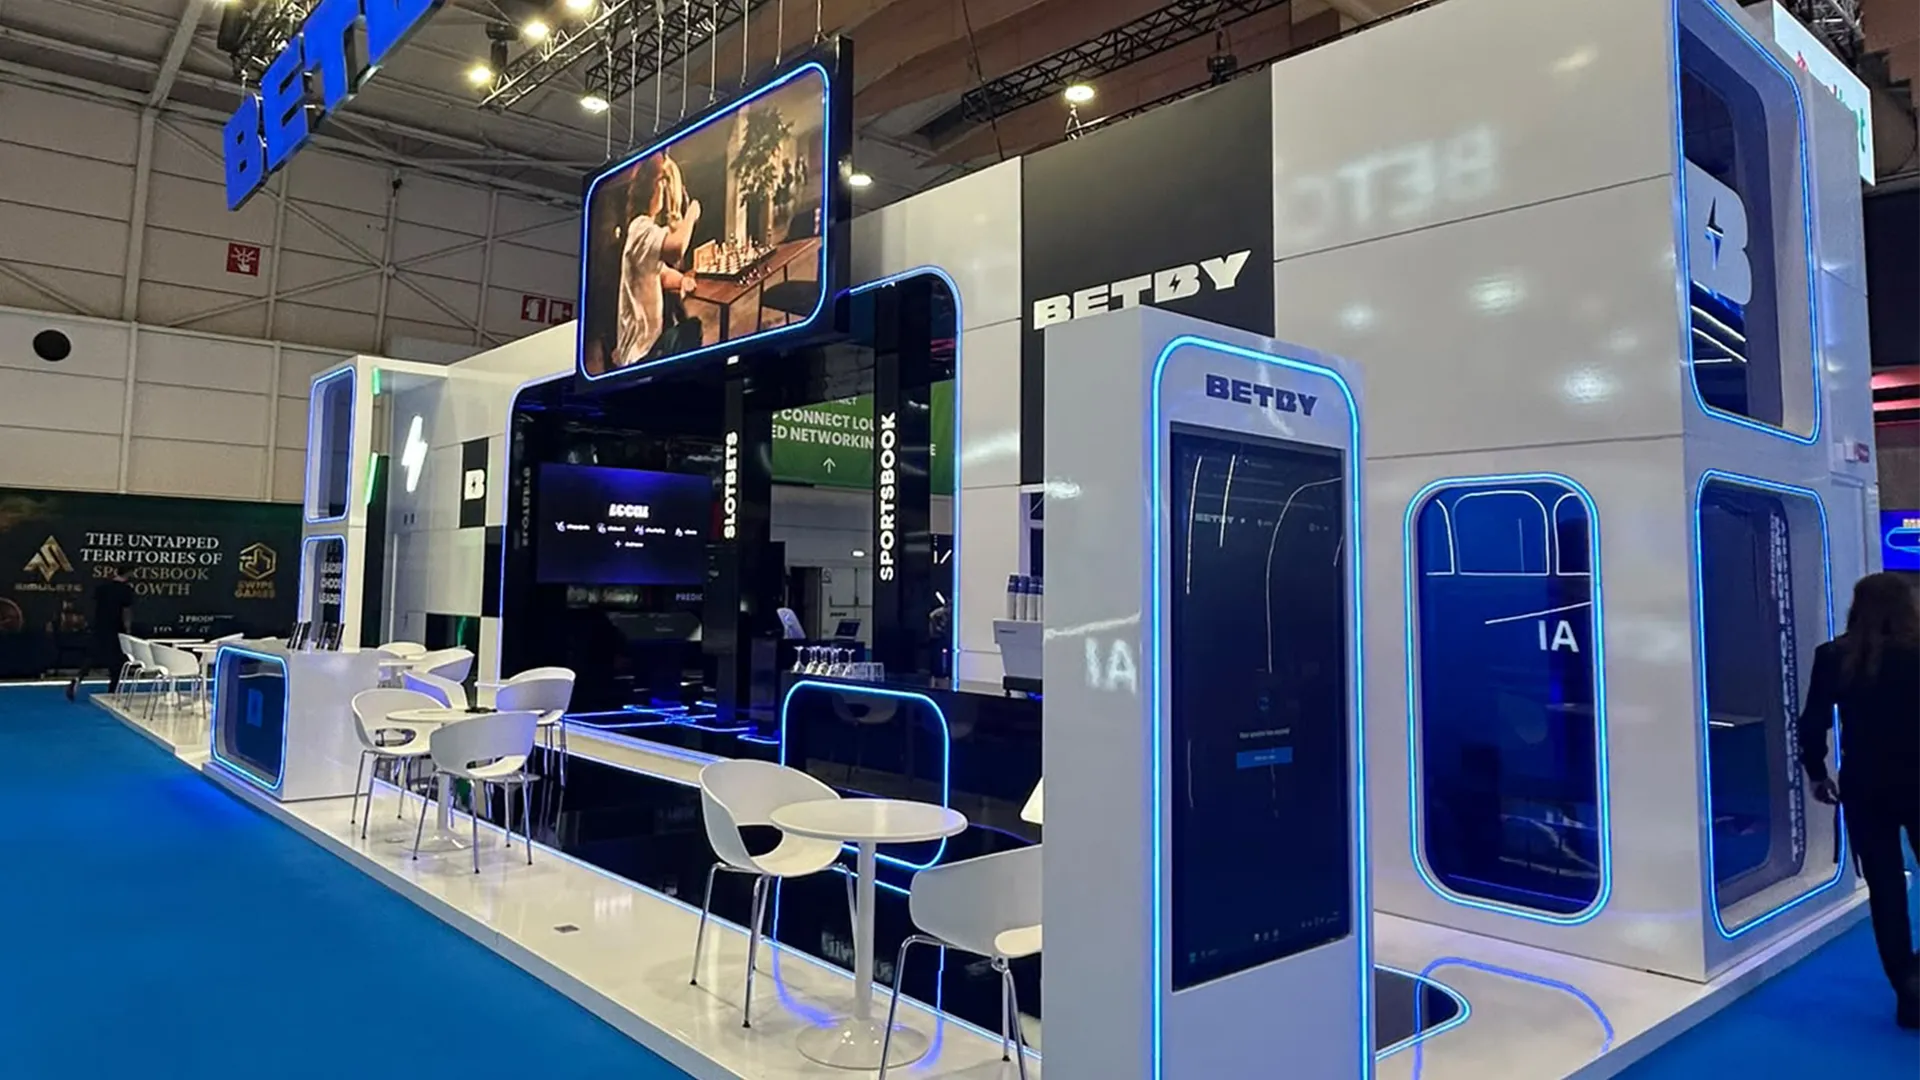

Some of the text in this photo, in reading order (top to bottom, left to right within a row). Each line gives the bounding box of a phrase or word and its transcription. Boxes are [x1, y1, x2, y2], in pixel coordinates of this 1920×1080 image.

[1033, 249, 1252, 330] BETBY
[1206, 374, 1318, 416] BETBY
[781, 408, 850, 428] CONNECT
[723, 431, 739, 539] SLOTBETS
[880, 412, 896, 581] SPORTSBOOK
[80, 548, 223, 565] TERRITORIES OF
[86, 532, 219, 549] THE UNTAPPED
